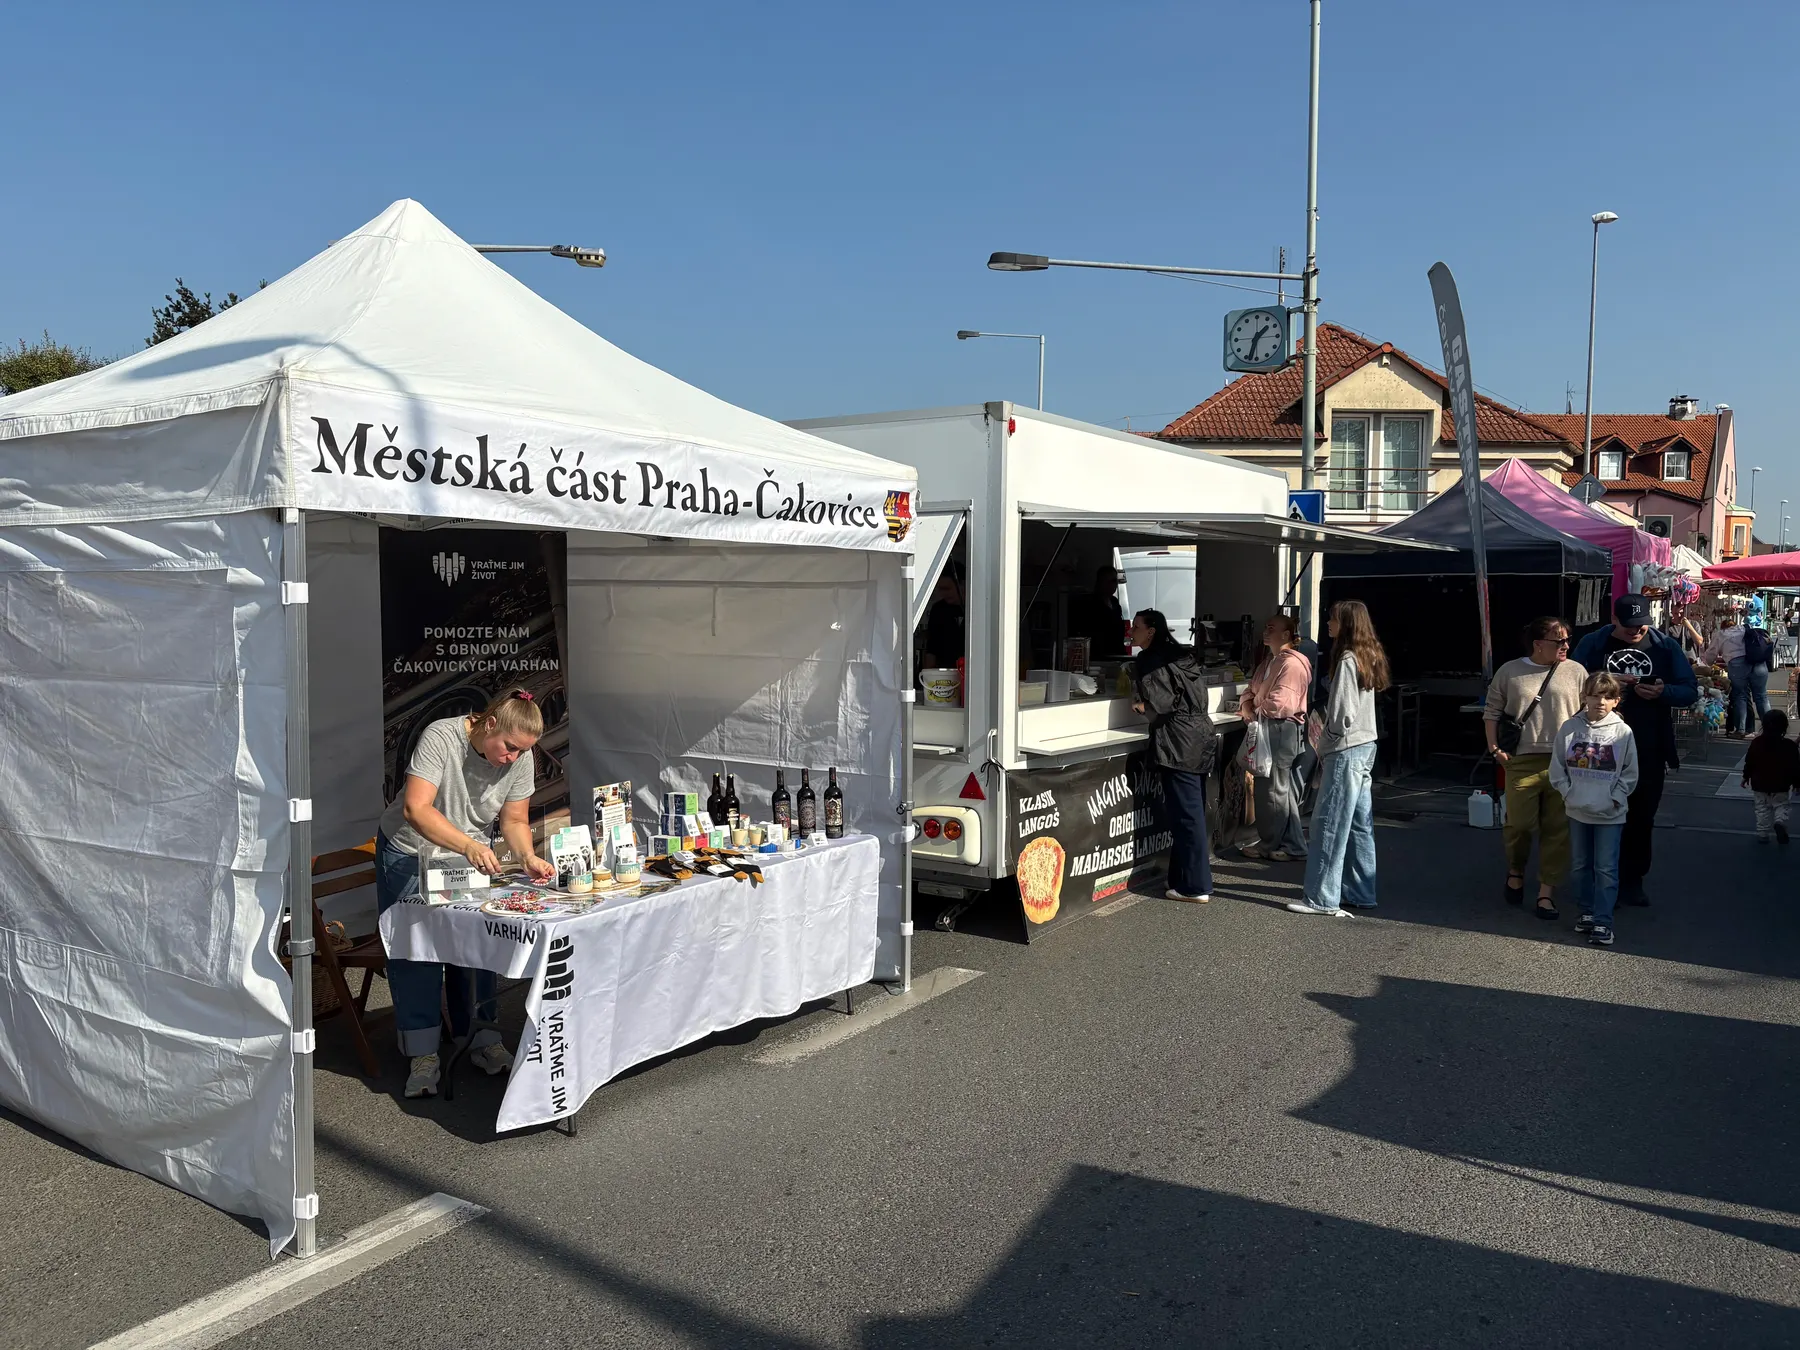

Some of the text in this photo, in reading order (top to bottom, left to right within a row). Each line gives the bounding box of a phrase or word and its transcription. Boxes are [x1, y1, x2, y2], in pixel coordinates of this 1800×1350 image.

[1452, 334, 1476, 504] GASTRO
[311, 416, 879, 529] Městská část Praha-Čakovice
[470, 559, 525, 570] VRAŤME JIM
[471, 570, 497, 580] ŽIVOT
[424, 624, 530, 638] POMOZTE NÁM
[435, 643, 519, 656] S OBNOVOU
[393, 658, 559, 673] ČAKOVICKÝCH VARHAN
[1019, 789, 1056, 814] KLASIK
[1087, 773, 1133, 824] MAGYAR
[1019, 807, 1060, 838] LANGOŠ
[1109, 802, 1154, 838] ORIGINÁL
[1069, 835, 1134, 877] MAĎARSKÉ
[450, 875, 467, 883] ŽIVOT
[548, 1009, 569, 1115] VRAŤME JIM
